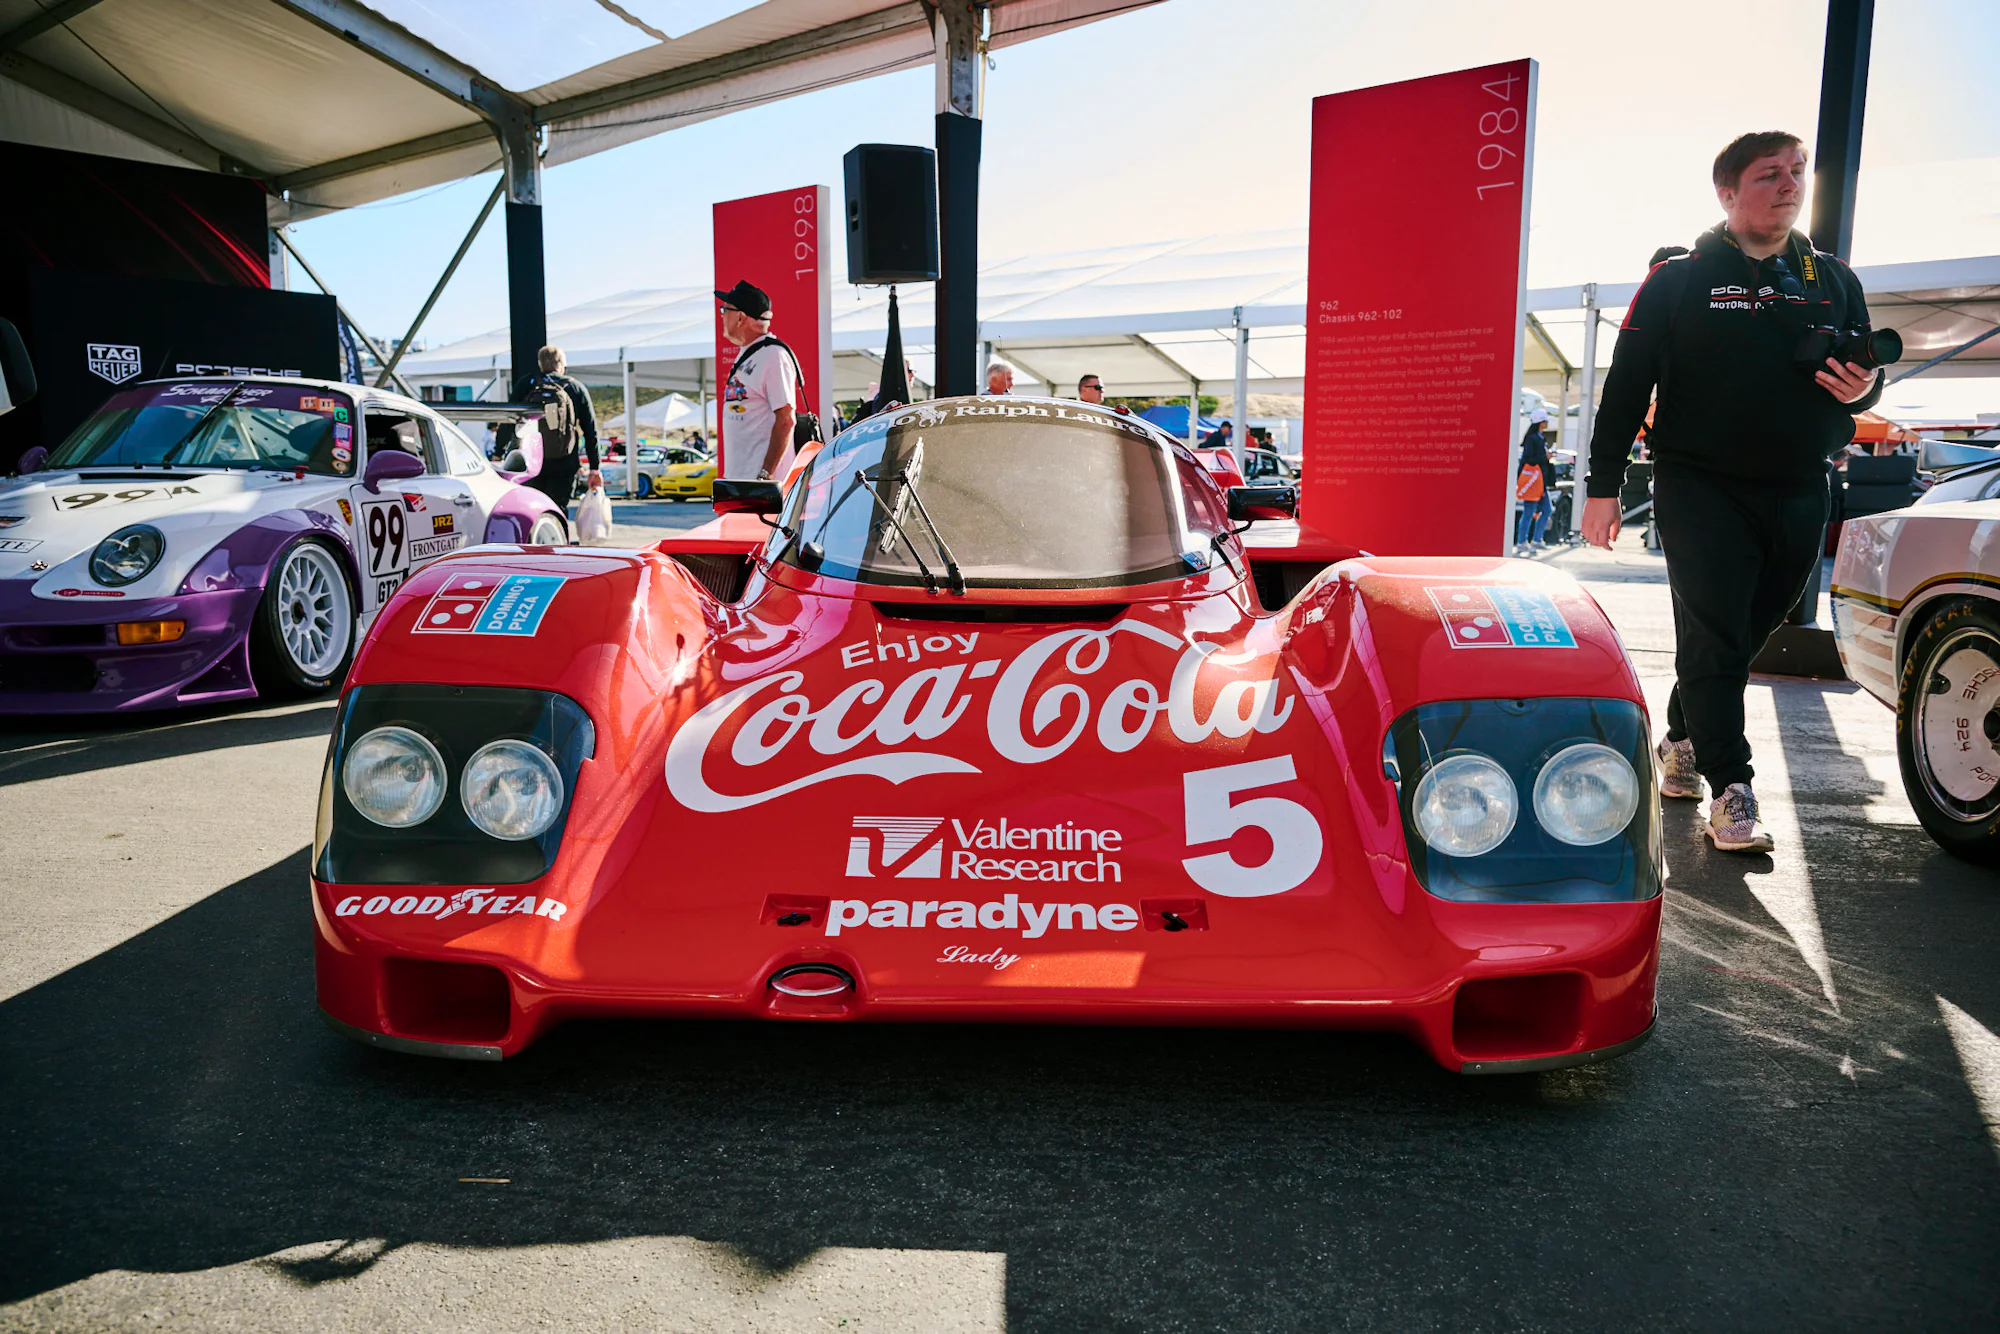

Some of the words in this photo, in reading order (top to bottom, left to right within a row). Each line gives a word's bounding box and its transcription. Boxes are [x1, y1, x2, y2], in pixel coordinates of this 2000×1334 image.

[1477, 72, 1521, 201] 1984
[794, 195, 815, 281] 1998
[1804, 255, 1815, 281] Nikon
[1318, 312, 1356, 324] Chassis
[1357, 309, 1403, 321] 962-102
[1319, 300, 1339, 311] 962
[1407, 329, 1435, 338] Porsche
[1435, 327, 1469, 338] produced
[1469, 326, 1482, 335] the
[92, 347, 136, 360] TAG
[1413, 355, 1440, 364] Porsche
[1459, 352, 1495, 363] Beginning
[92, 361, 138, 382] HEUER
[1407, 366, 1434, 375] Porsche
[1456, 378, 1481, 386] behind
[1427, 391, 1461, 401] extending
[1461, 390, 1475, 399] the
[1456, 403, 1469, 412] the
[336, 411, 347, 421] C
[850, 412, 917, 442] Polo
[953, 403, 1049, 419] Ralph
[62, 488, 155, 509] 99
[434, 515, 453, 528] JRZ
[369, 504, 405, 573] 99
[487, 578, 532, 630] DOMINO'S
[508, 596, 539, 631] PIZZA
[840, 631, 981, 670] Enjoy
[664, 619, 1296, 812] Coca-Cola
[1955, 717, 1972, 752] 924
[950, 818, 1122, 853] Valentine
[1181, 754, 1324, 898] 5
[950, 852, 1122, 883] Research
[335, 892, 568, 922] GOODYEAR
[825, 894, 1139, 939] paradyne
[935, 944, 1022, 972] Lady
